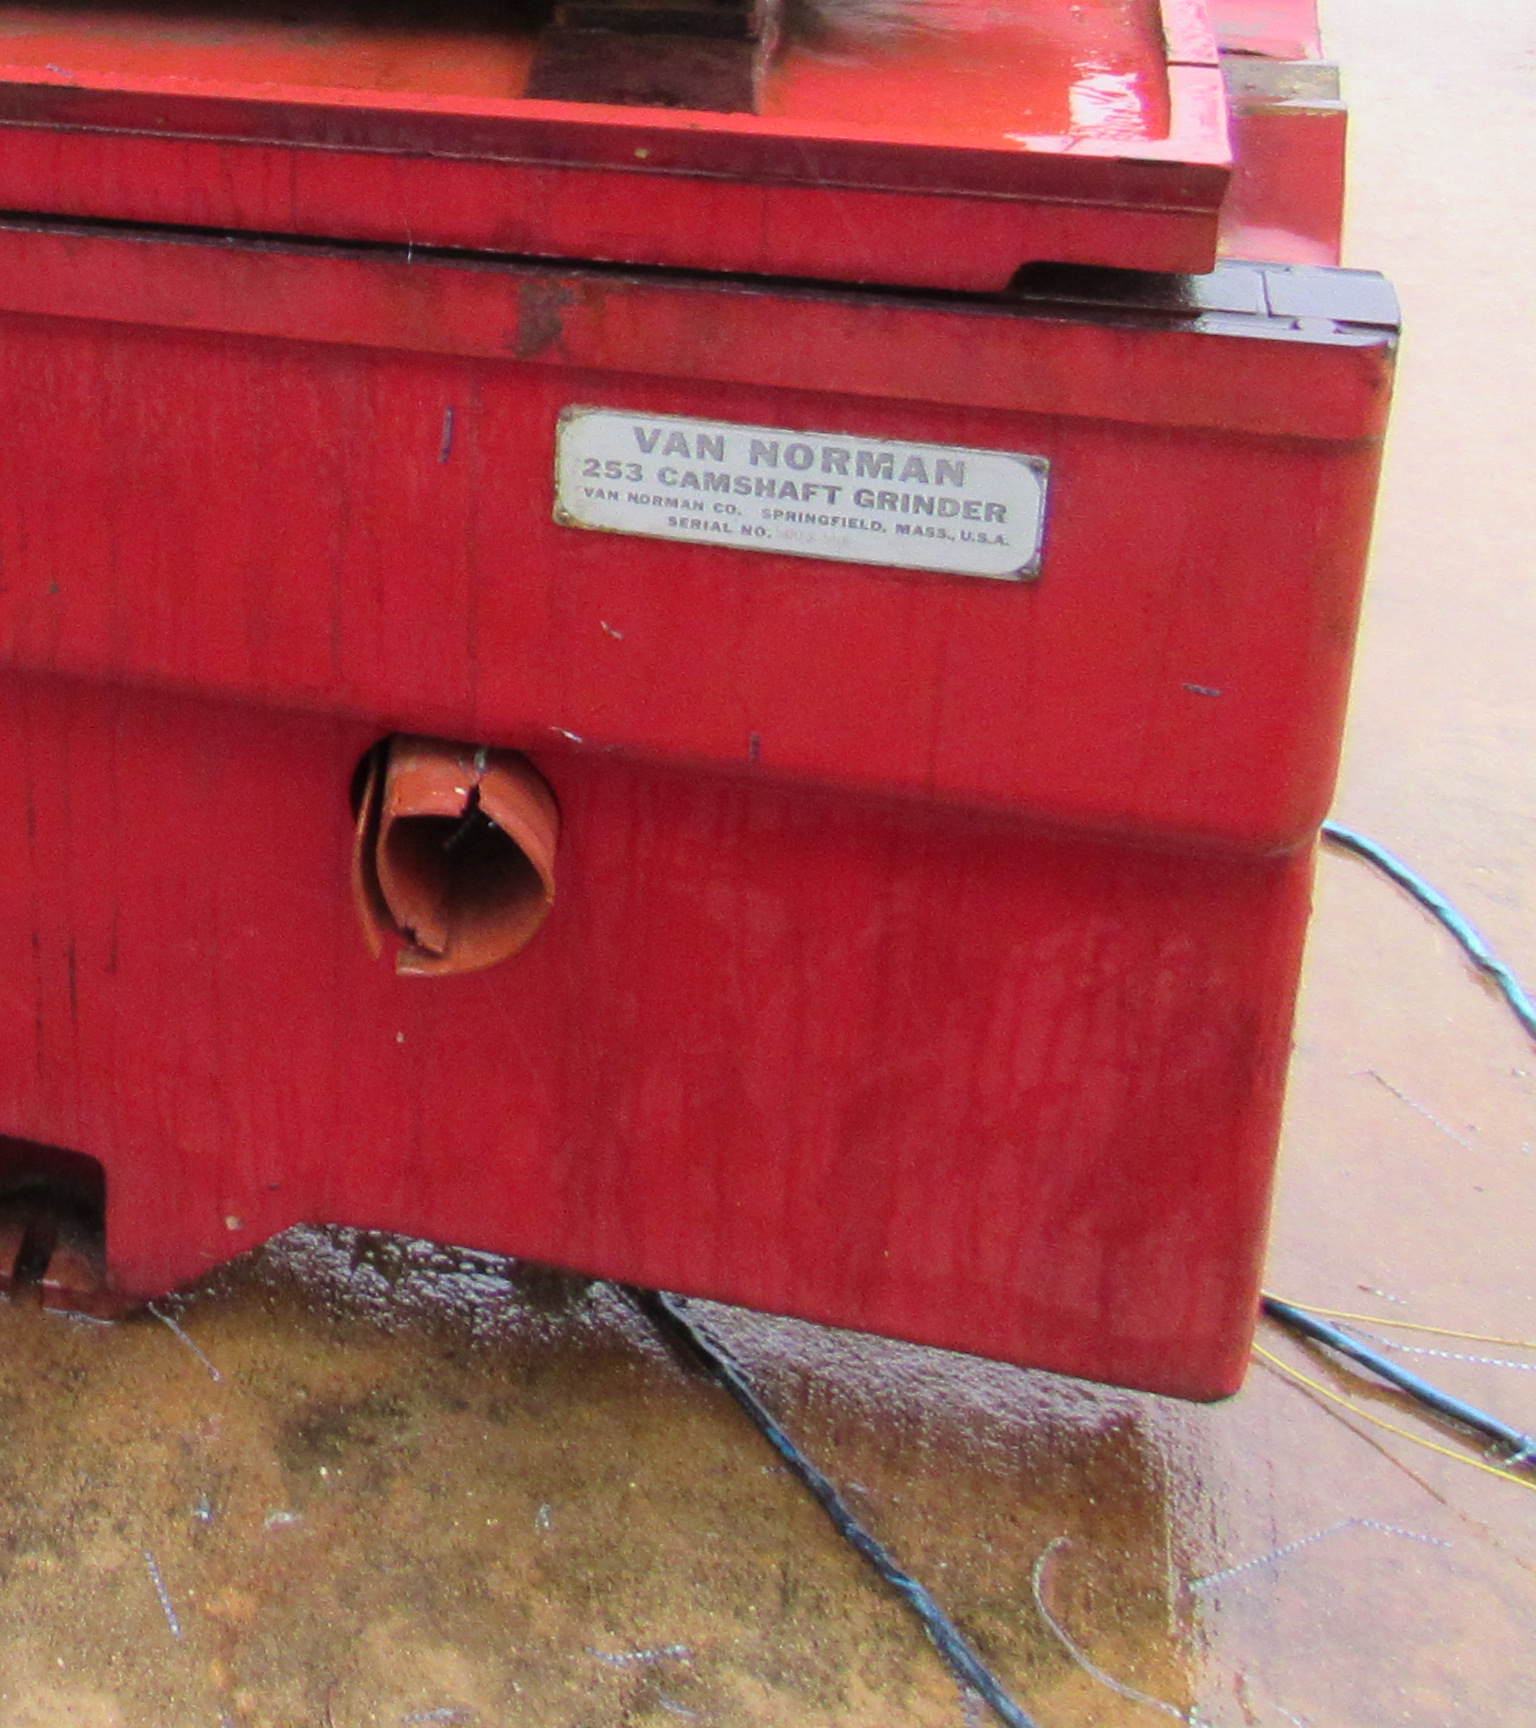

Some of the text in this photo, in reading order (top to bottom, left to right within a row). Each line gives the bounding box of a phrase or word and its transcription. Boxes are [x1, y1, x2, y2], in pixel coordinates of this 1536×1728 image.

[633, 426, 966, 487] VAN NORMAN
[581, 457, 1008, 523] 253 CAMSHAFT GRINDER
[583, 487, 619, 501] VAN
[627, 492, 705, 512] NORMAN
[713, 502, 743, 516] CO.
[960, 529, 1010, 546] U.S.A.
[667, 515, 733, 534] SERIAL
[740, 524, 773, 539] NO.
